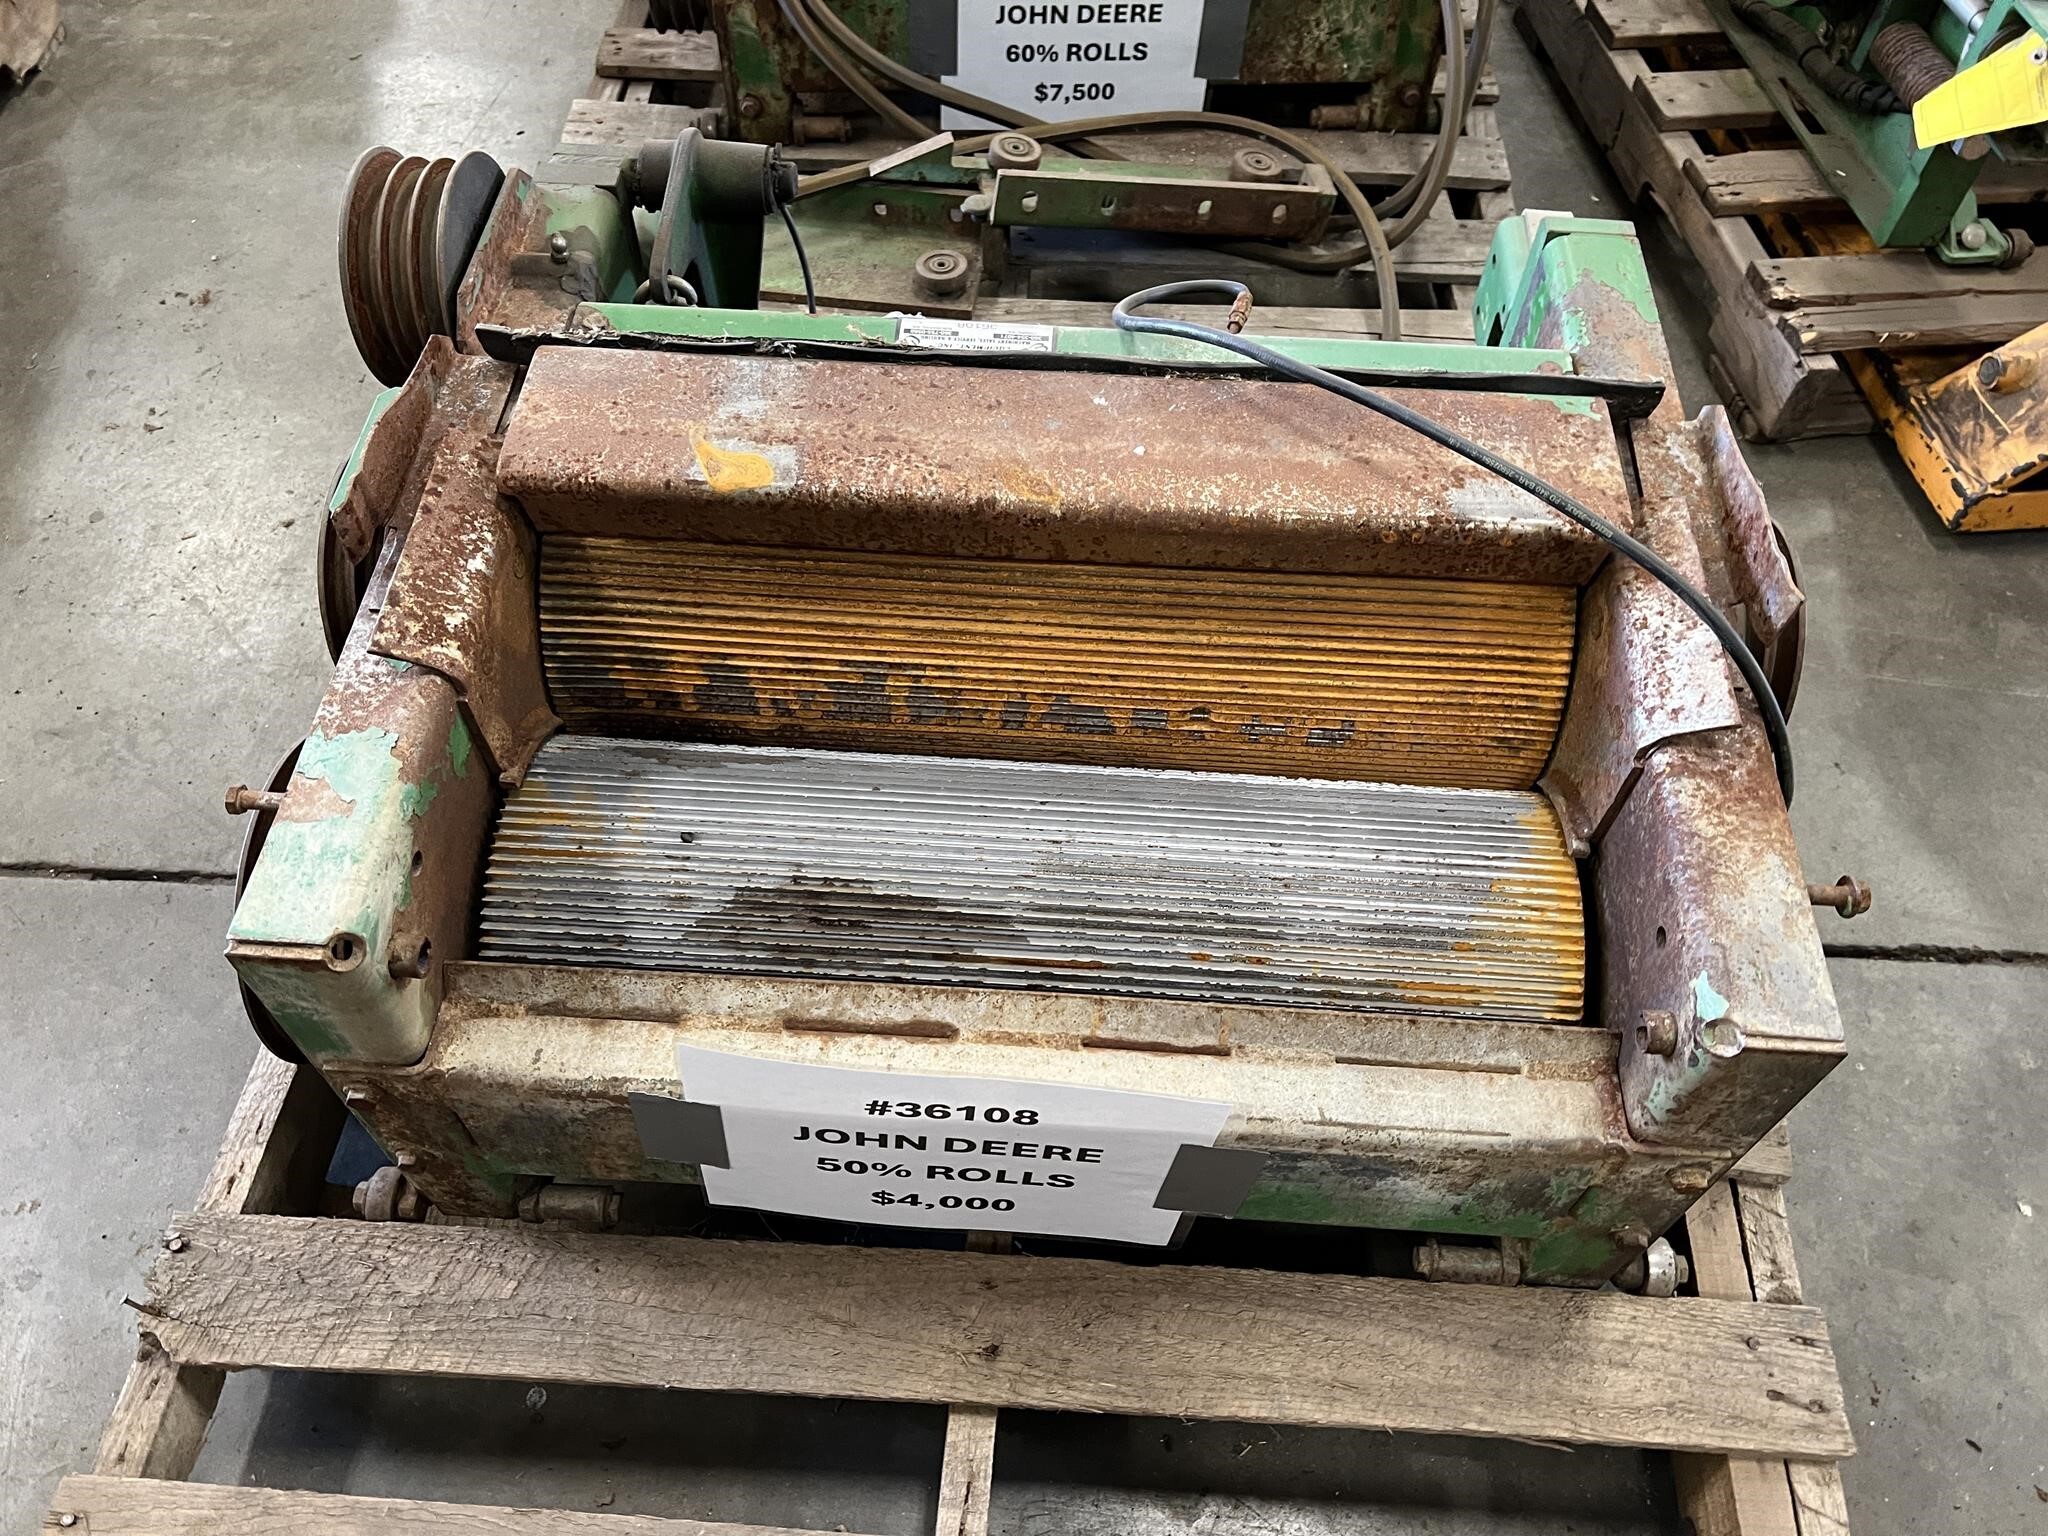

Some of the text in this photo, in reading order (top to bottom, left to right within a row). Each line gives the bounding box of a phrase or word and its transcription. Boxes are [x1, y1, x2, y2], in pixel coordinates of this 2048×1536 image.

[995, 3, 1164, 25] JOHN DEERE
[1006, 42, 1149, 63] 60% ROLLS
[1034, 82, 1116, 104] $7,500
[864, 1100, 1039, 1126] #36108
[793, 1126, 1105, 1164] JOHN DEERE
[816, 1156, 1076, 1189] 50% ROLLS
[870, 1189, 1016, 1212] $4,000
